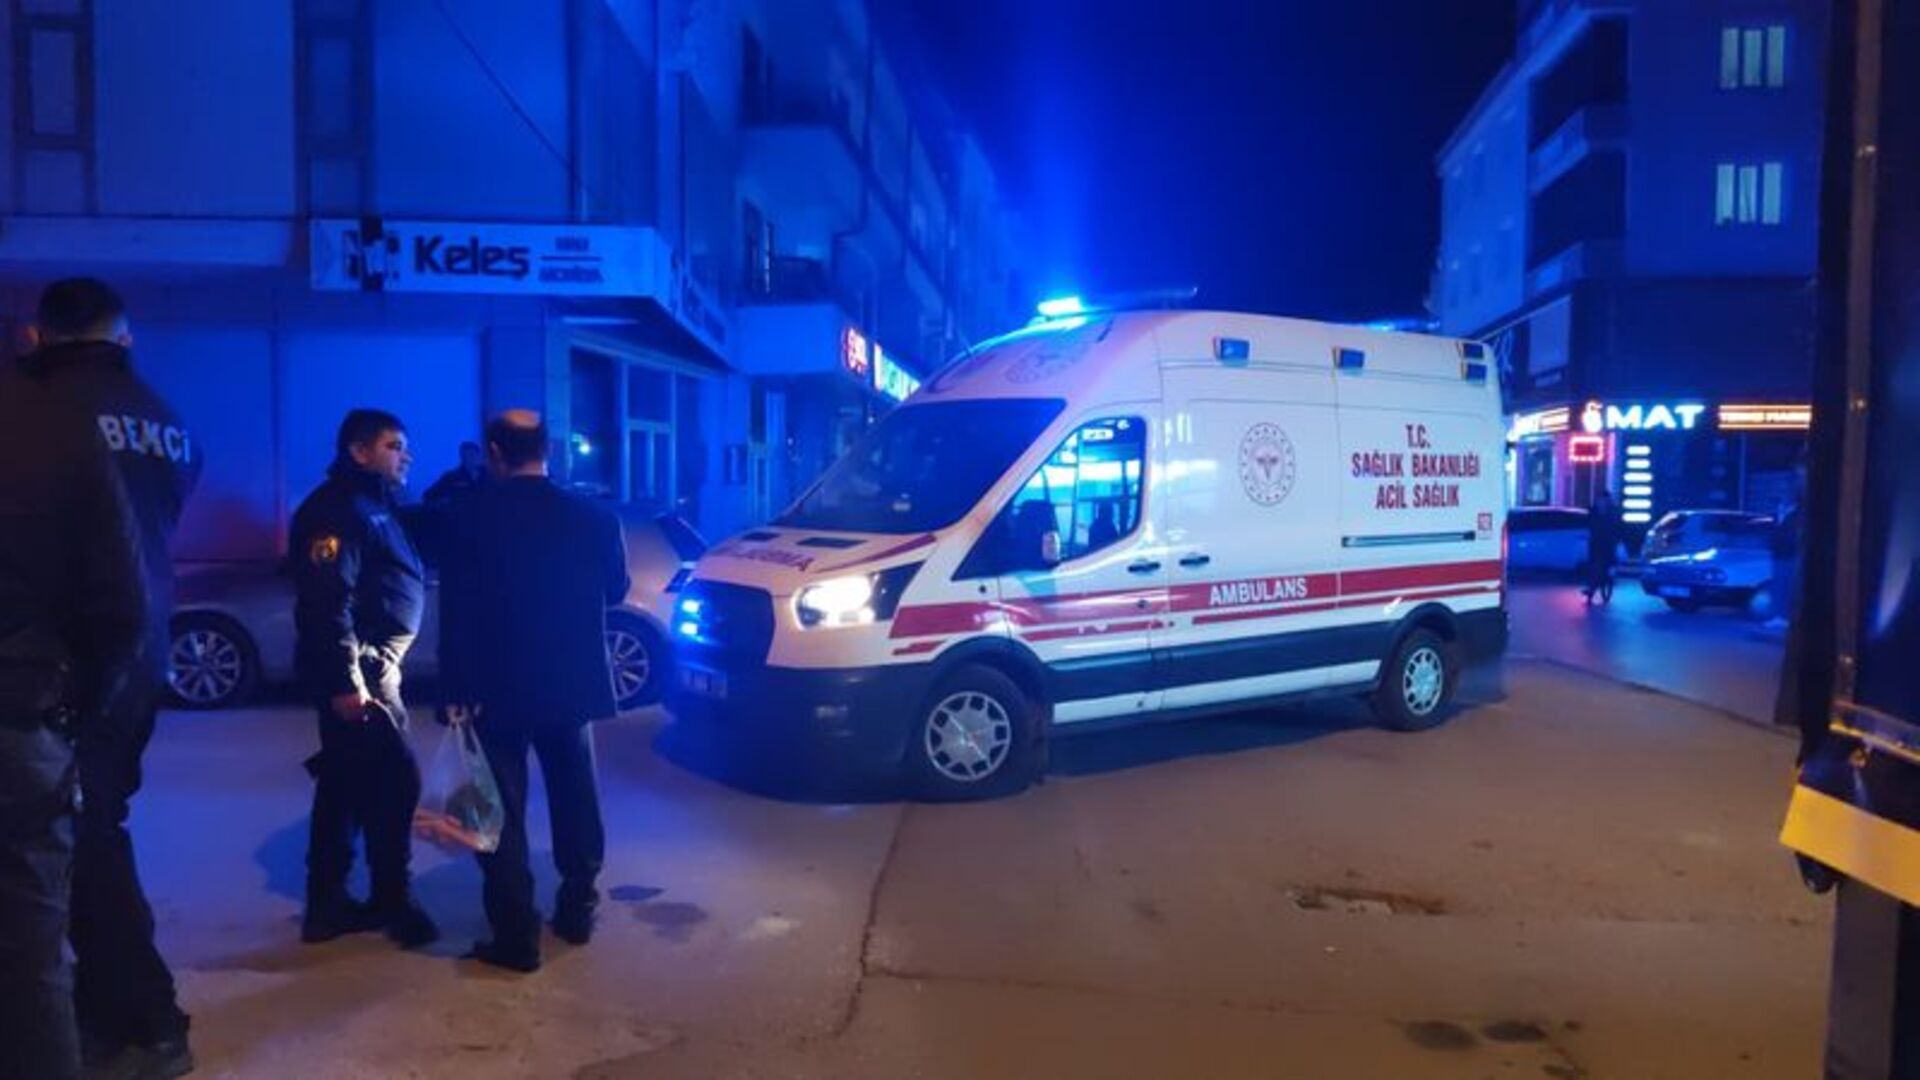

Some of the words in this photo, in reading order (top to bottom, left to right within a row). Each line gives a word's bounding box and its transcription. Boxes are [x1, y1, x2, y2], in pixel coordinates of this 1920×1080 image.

[414, 236, 530, 280] Keleş
[1406, 424, 1431, 448] T.C.
[1352, 450, 1404, 477] SAĞLIK
[1412, 451, 1480, 477] BAKANLIĞI
[1376, 480, 1406, 509] ACİL
[1413, 481, 1459, 508] SAĞLIK
[1209, 577, 1307, 606] AMBULANS
